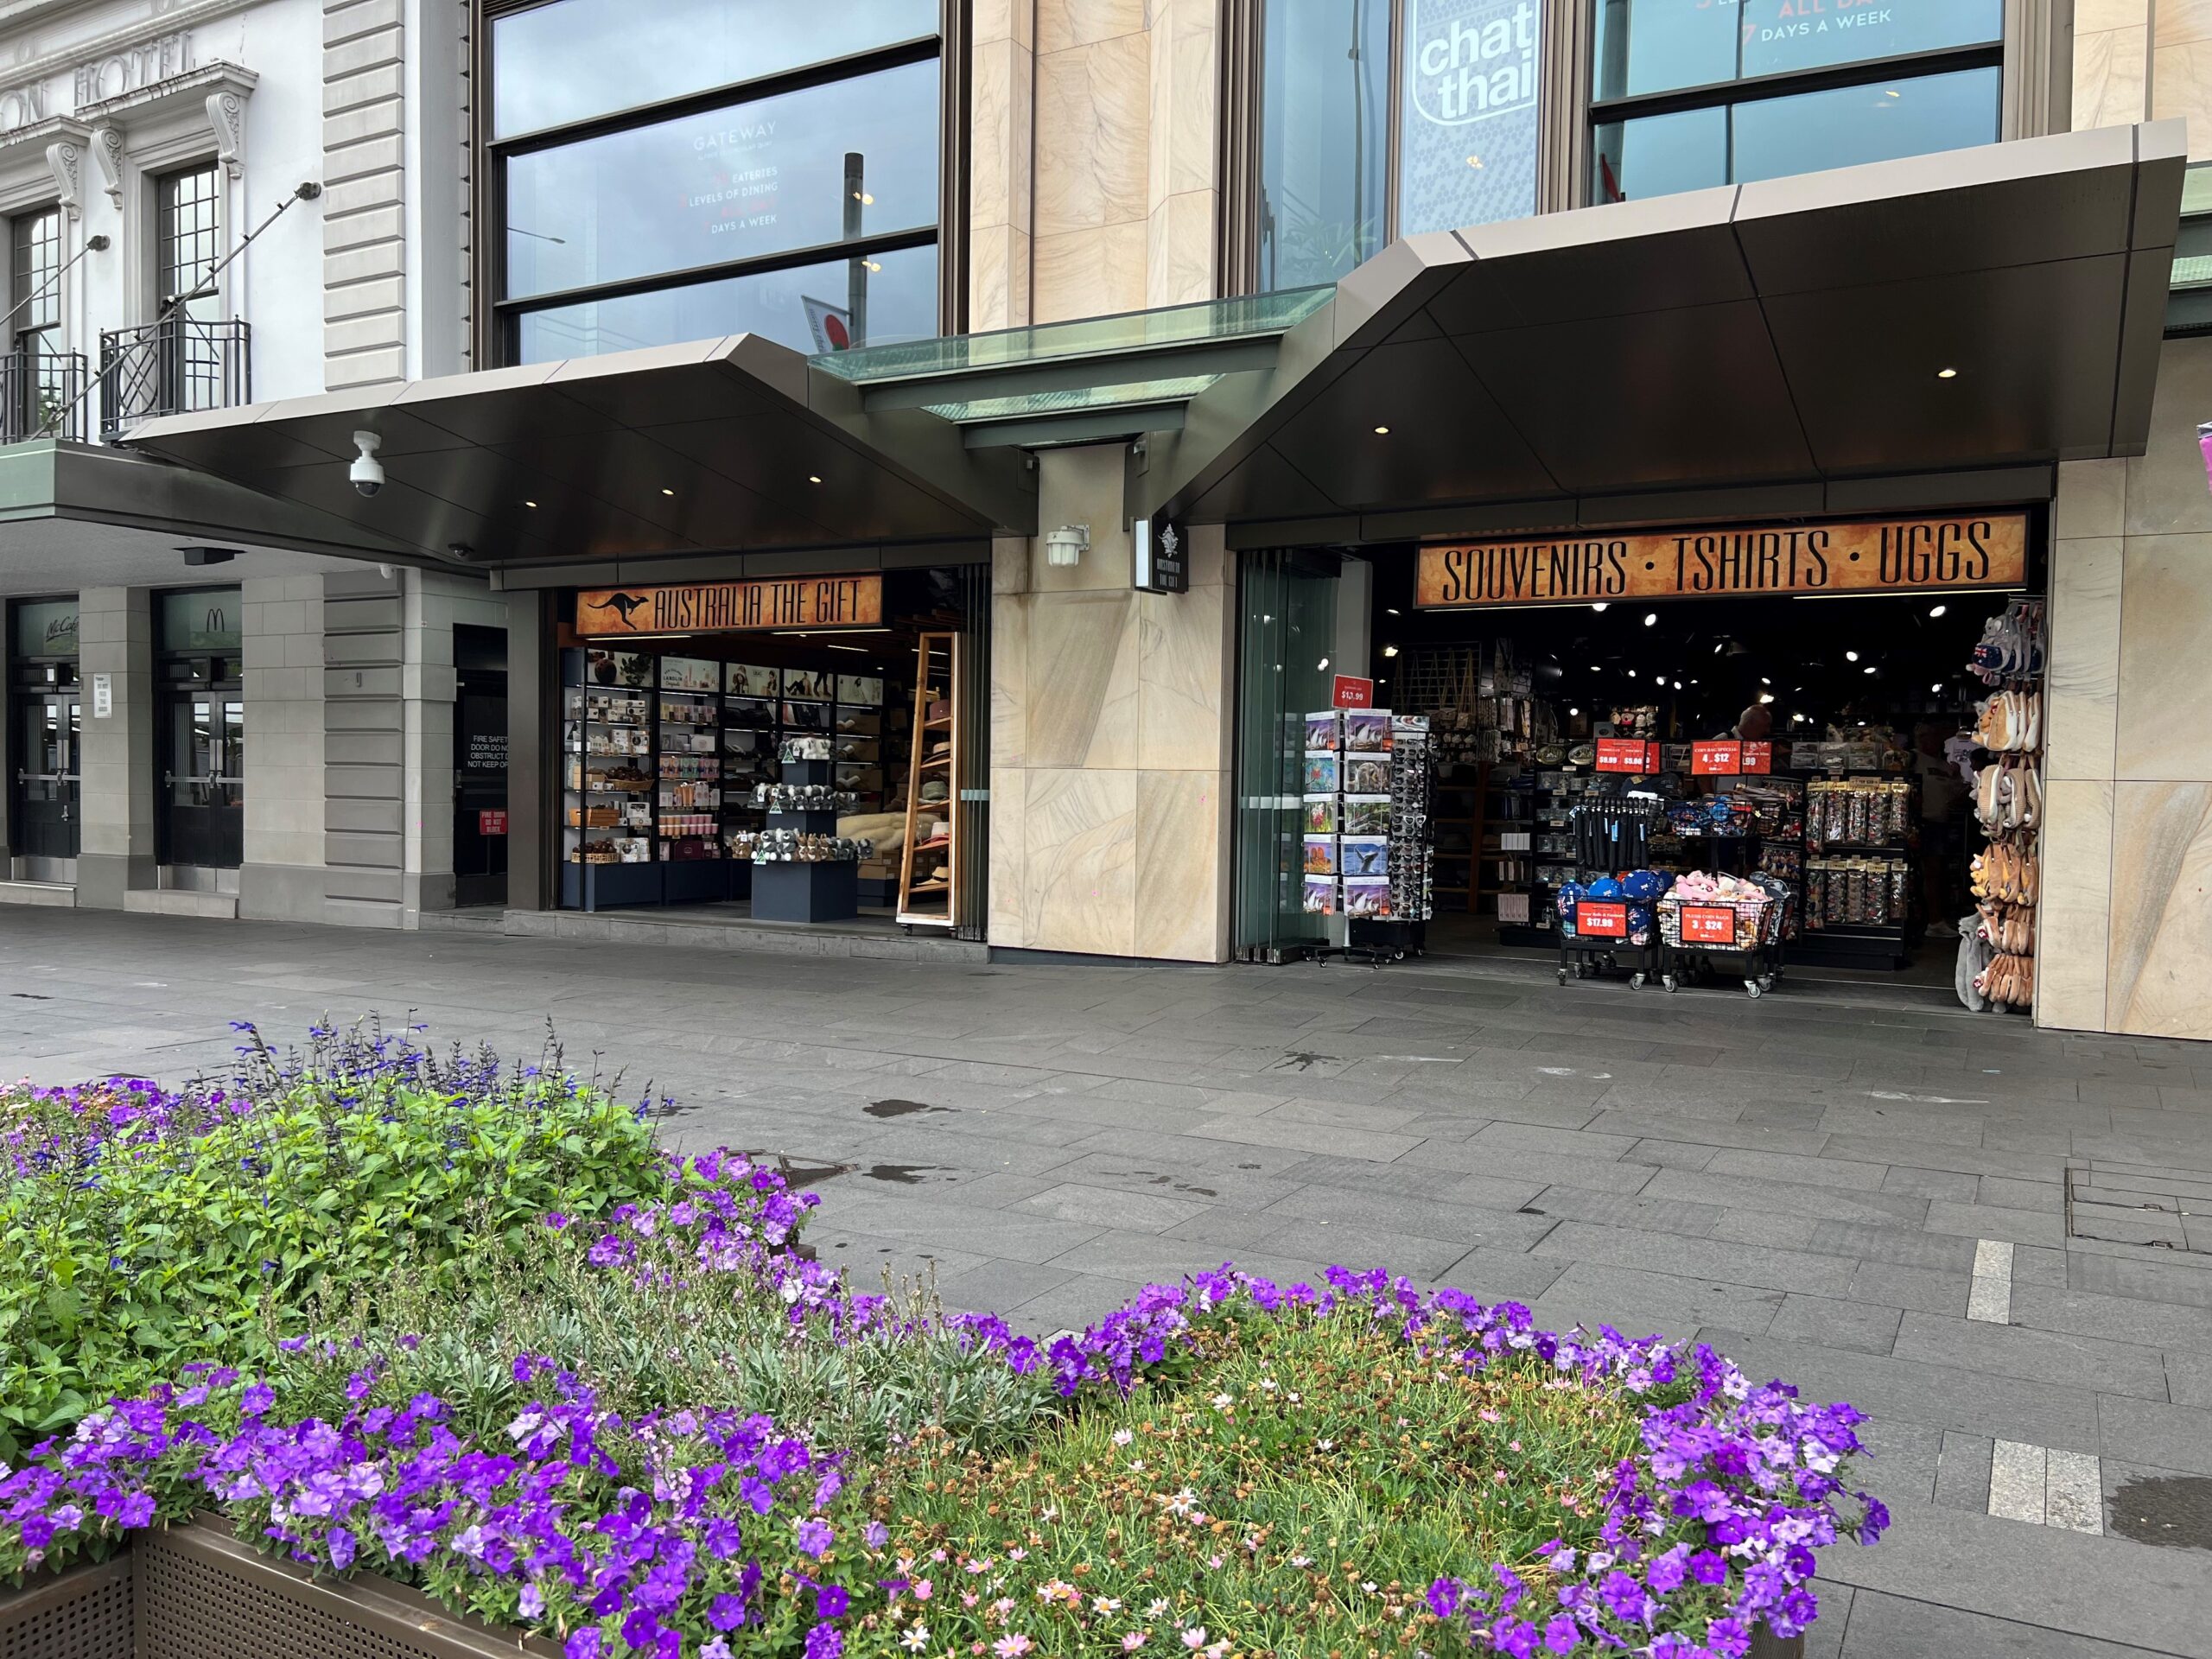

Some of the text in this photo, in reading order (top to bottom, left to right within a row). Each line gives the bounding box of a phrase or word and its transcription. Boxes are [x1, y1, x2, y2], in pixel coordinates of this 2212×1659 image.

[1762, 22, 1809, 42] DAYS
[1816, 20, 1828, 34] A
[1836, 9, 1891, 29] WEEK
[1420, 2, 1533, 76] chat
[1437, 48, 1533, 119] thai
[694, 121, 776, 151] GATEWAY
[732, 166, 778, 183] EATERIES
[689, 192, 722, 207] LEVELS
[726, 188, 739, 200] OF
[741, 181, 779, 197] DINING
[711, 221, 736, 234] DAYS
[740, 219, 746, 229] A
[748, 213, 777, 227] WEEK
[1442, 521, 1991, 602] SOUVENIRS TSHIRTS UGGS
[654, 579, 861, 630] AUSTRALIA THE GIFT
[473, 734, 487, 743] FIRE
[470, 752, 504, 760] OBSTRUCT
[1702, 753, 1708, 763] 4
[1713, 753, 1729, 763] $12
[1586, 917, 1613, 928] $17.99
[1692, 919, 1722, 931] 3 $24
